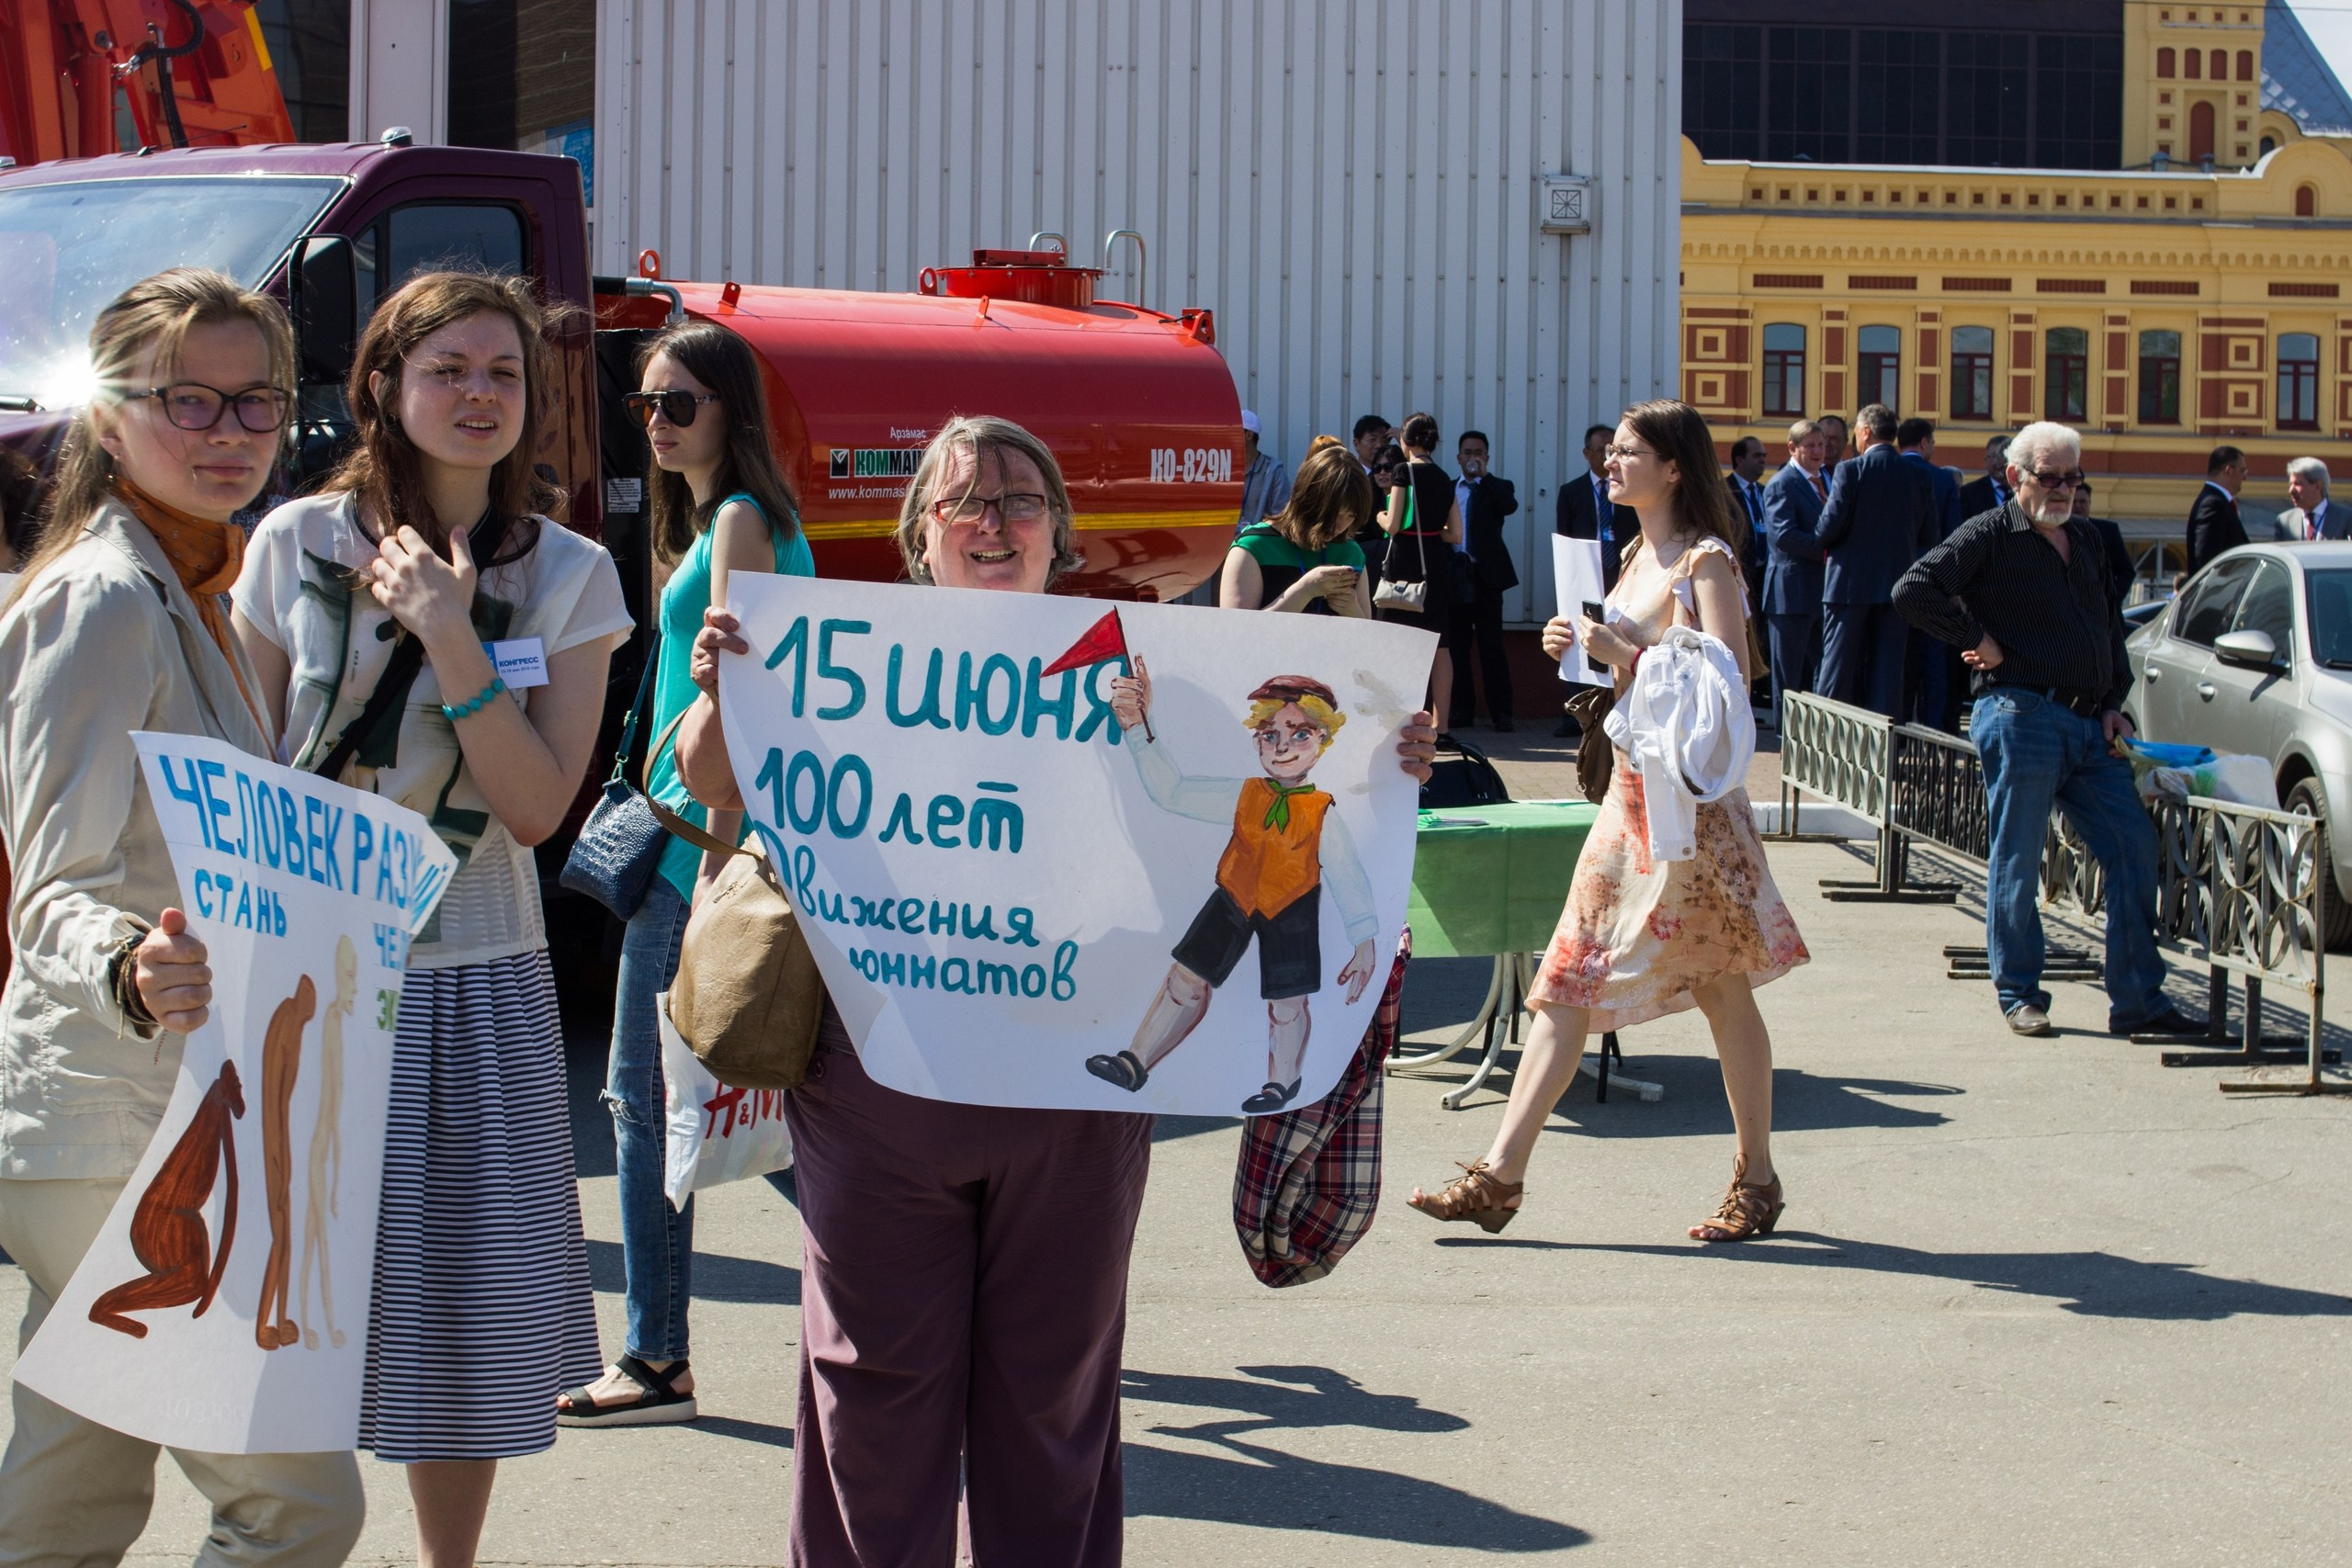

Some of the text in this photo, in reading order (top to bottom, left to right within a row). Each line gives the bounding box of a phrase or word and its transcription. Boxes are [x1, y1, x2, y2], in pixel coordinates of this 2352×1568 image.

[890, 426, 927, 441] Арзамас
[829, 485, 908, 500] www.kommas
[499, 657, 539, 668] КОНГРЕСС
[764, 616, 872, 721] 15
[159, 754, 343, 891] ЧЕЛОВЕК
[755, 747, 1024, 853] 100 лет
[195, 869, 287, 938] СТАНЬ
[374, 922, 410, 972] ЧЕ
[849, 940, 1079, 1001] юннатов
